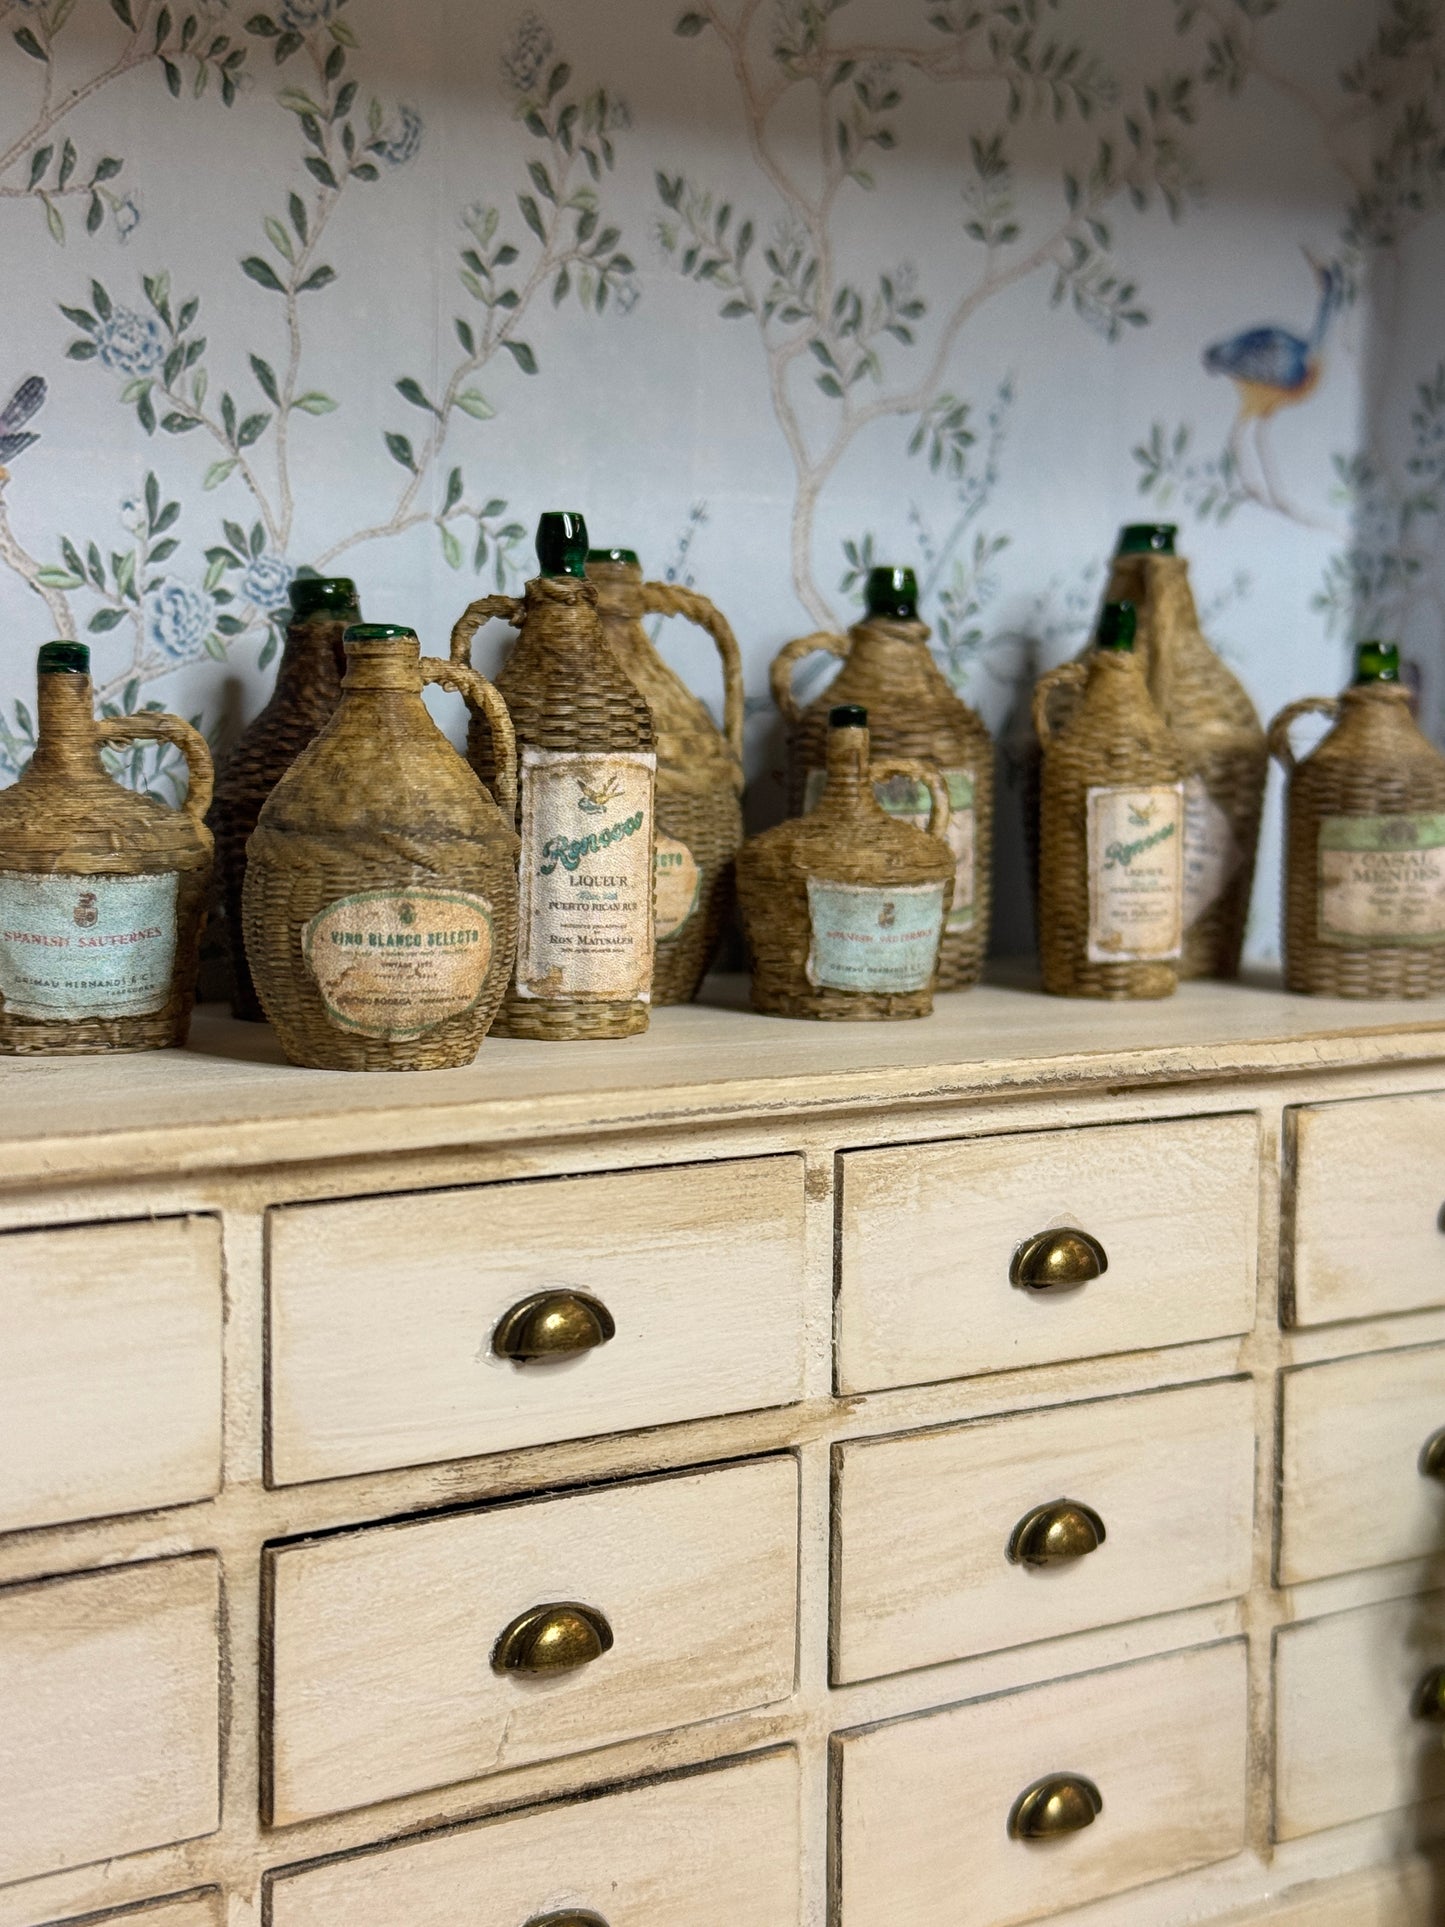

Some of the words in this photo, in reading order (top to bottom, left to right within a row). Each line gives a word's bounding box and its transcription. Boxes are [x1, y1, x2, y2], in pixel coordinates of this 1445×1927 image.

[570, 875, 628, 888] LIQUEUR
[548, 901, 590, 911] PUERTO
[4, 931, 70, 947] SPANISH
[78, 926, 162, 948] SAUTERNES
[331, 931, 363, 946] VINO
[368, 932, 422, 948] BLANCO
[427, 930, 479, 946] SELECTO
